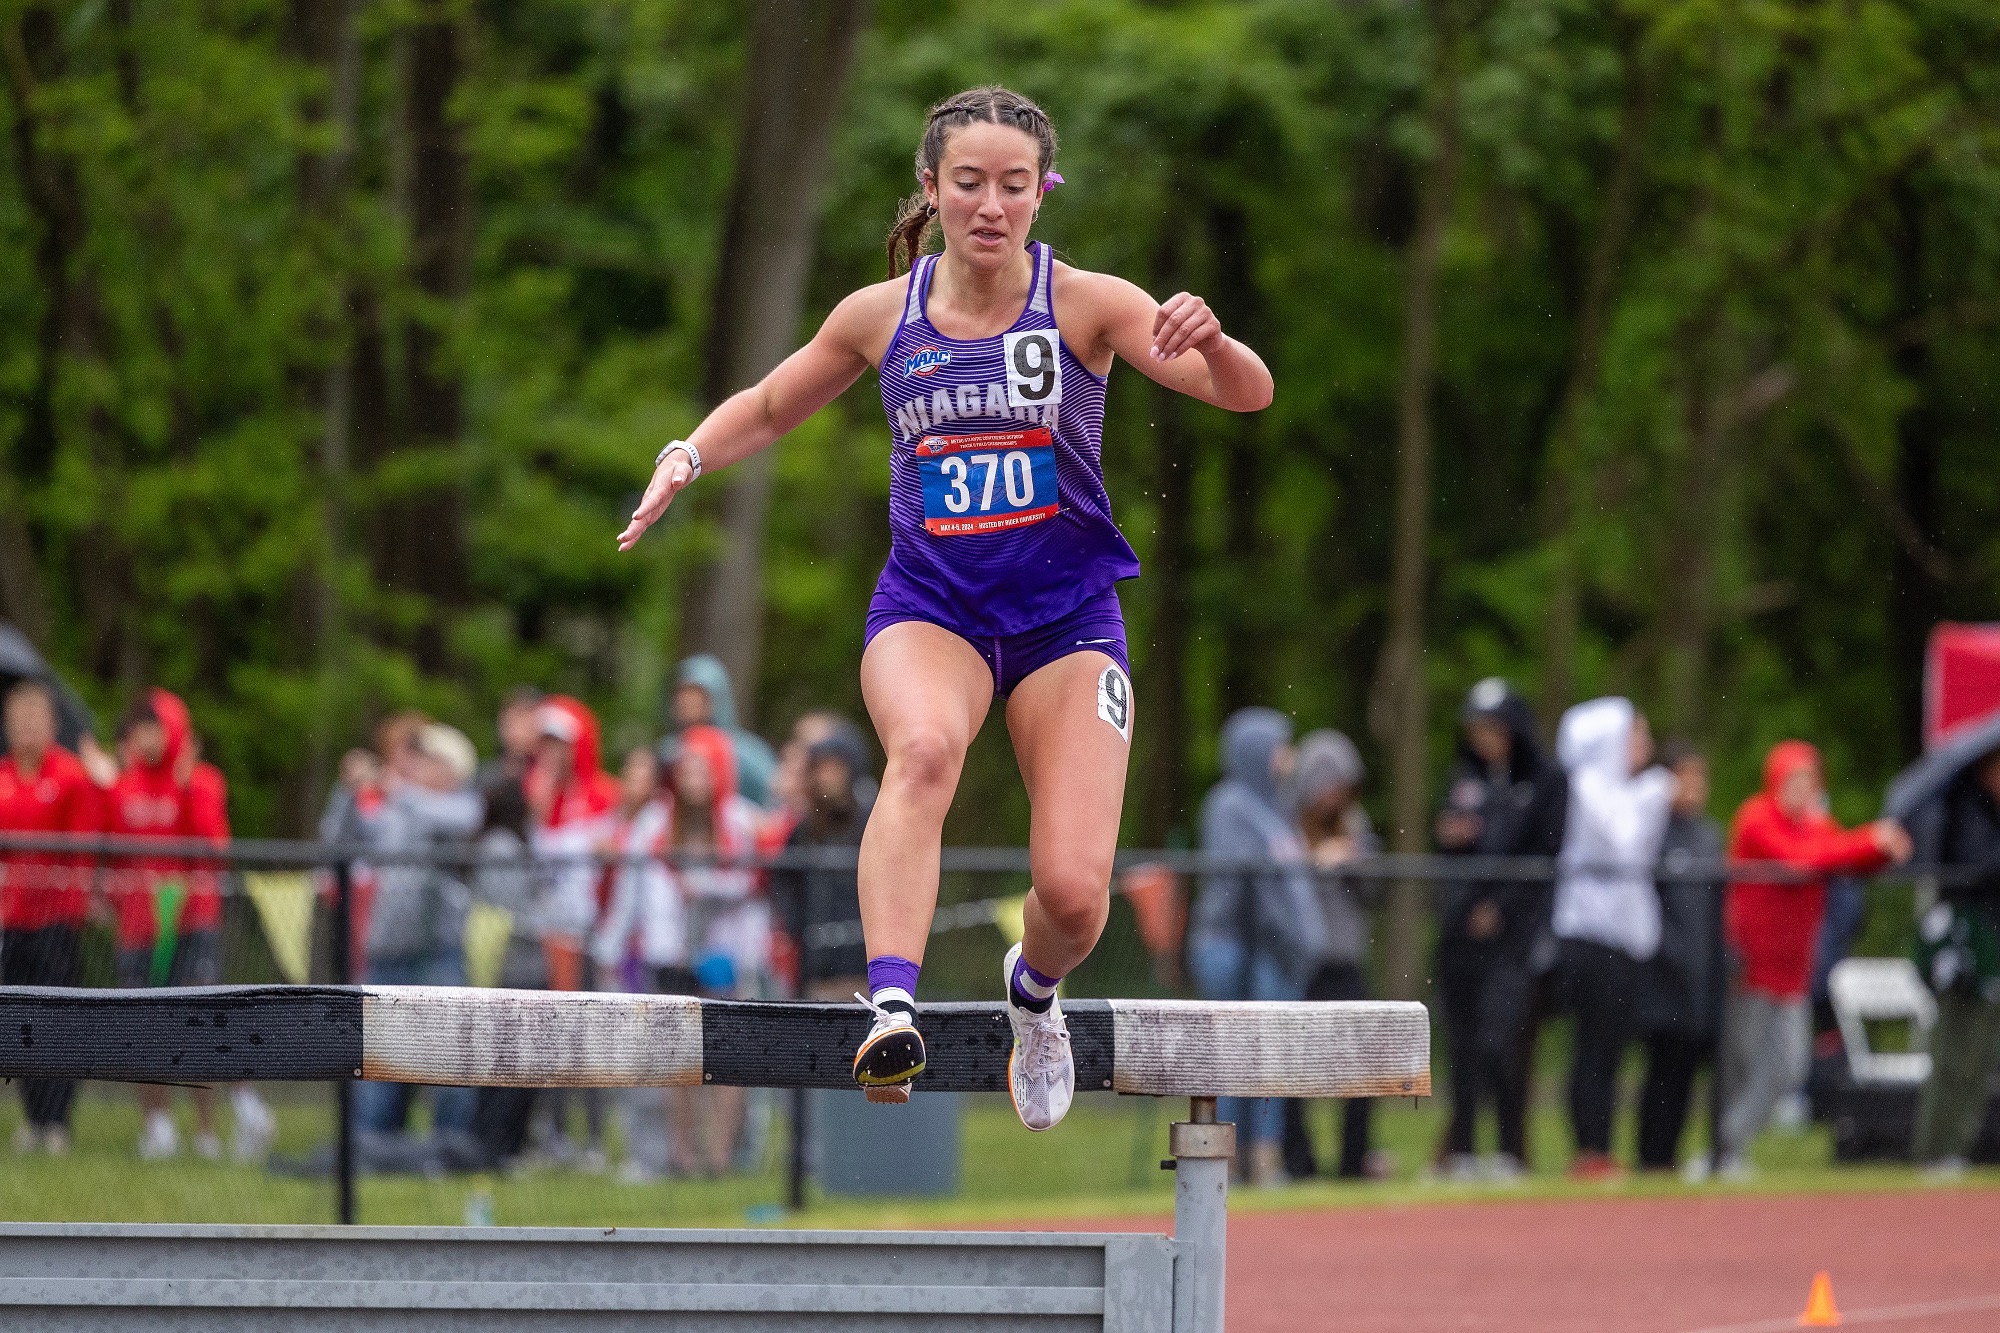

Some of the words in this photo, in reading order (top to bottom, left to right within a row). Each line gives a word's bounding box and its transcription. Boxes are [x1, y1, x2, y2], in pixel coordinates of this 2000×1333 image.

[903, 350, 951, 378] MAAC
[1013, 334, 1056, 401] 9
[940, 450, 1035, 513] 370
[940, 524, 951, 532] MAY
[961, 523, 974, 531] 2024
[978, 521, 998, 529] HOSTED
[997, 520, 1004, 528] BY
[1019, 513, 1046, 523] UNIVERSITY
[1105, 669, 1127, 730] 9
